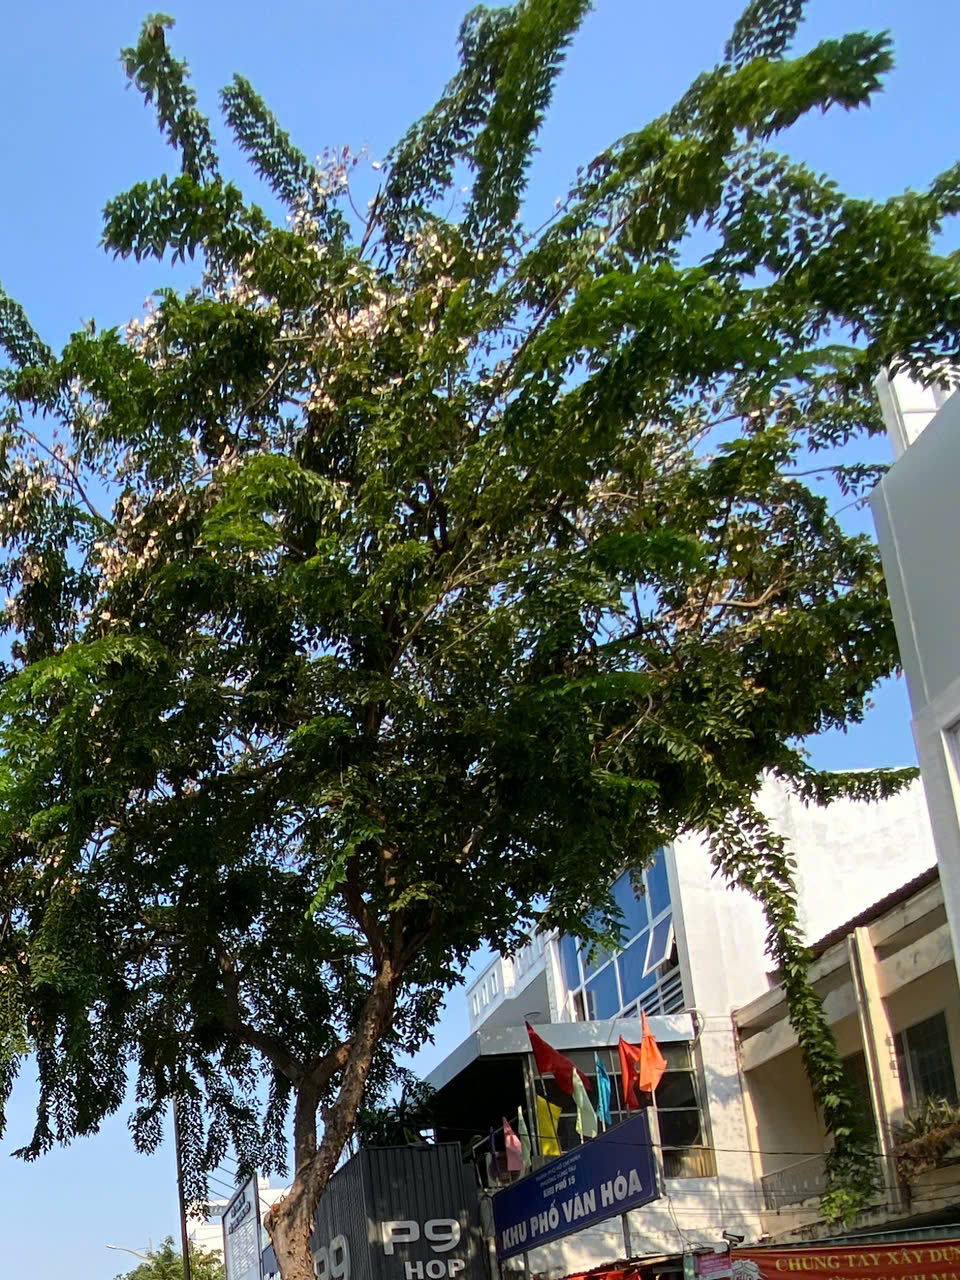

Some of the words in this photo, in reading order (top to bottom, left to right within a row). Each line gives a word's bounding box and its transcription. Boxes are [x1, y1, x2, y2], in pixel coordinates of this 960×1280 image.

[568, 1175, 576, 1186] 15
[502, 1220, 527, 1250] KHU
[530, 1198, 560, 1238] PHỐ
[562, 1189, 597, 1223] VĂN
[600, 1169, 643, 1208] HÓA
[381, 1218, 461, 1256] P9
[776, 1255, 840, 1272] CHUNG
[844, 1253, 881, 1268] TAY
[888, 1248, 925, 1265] XÂY
